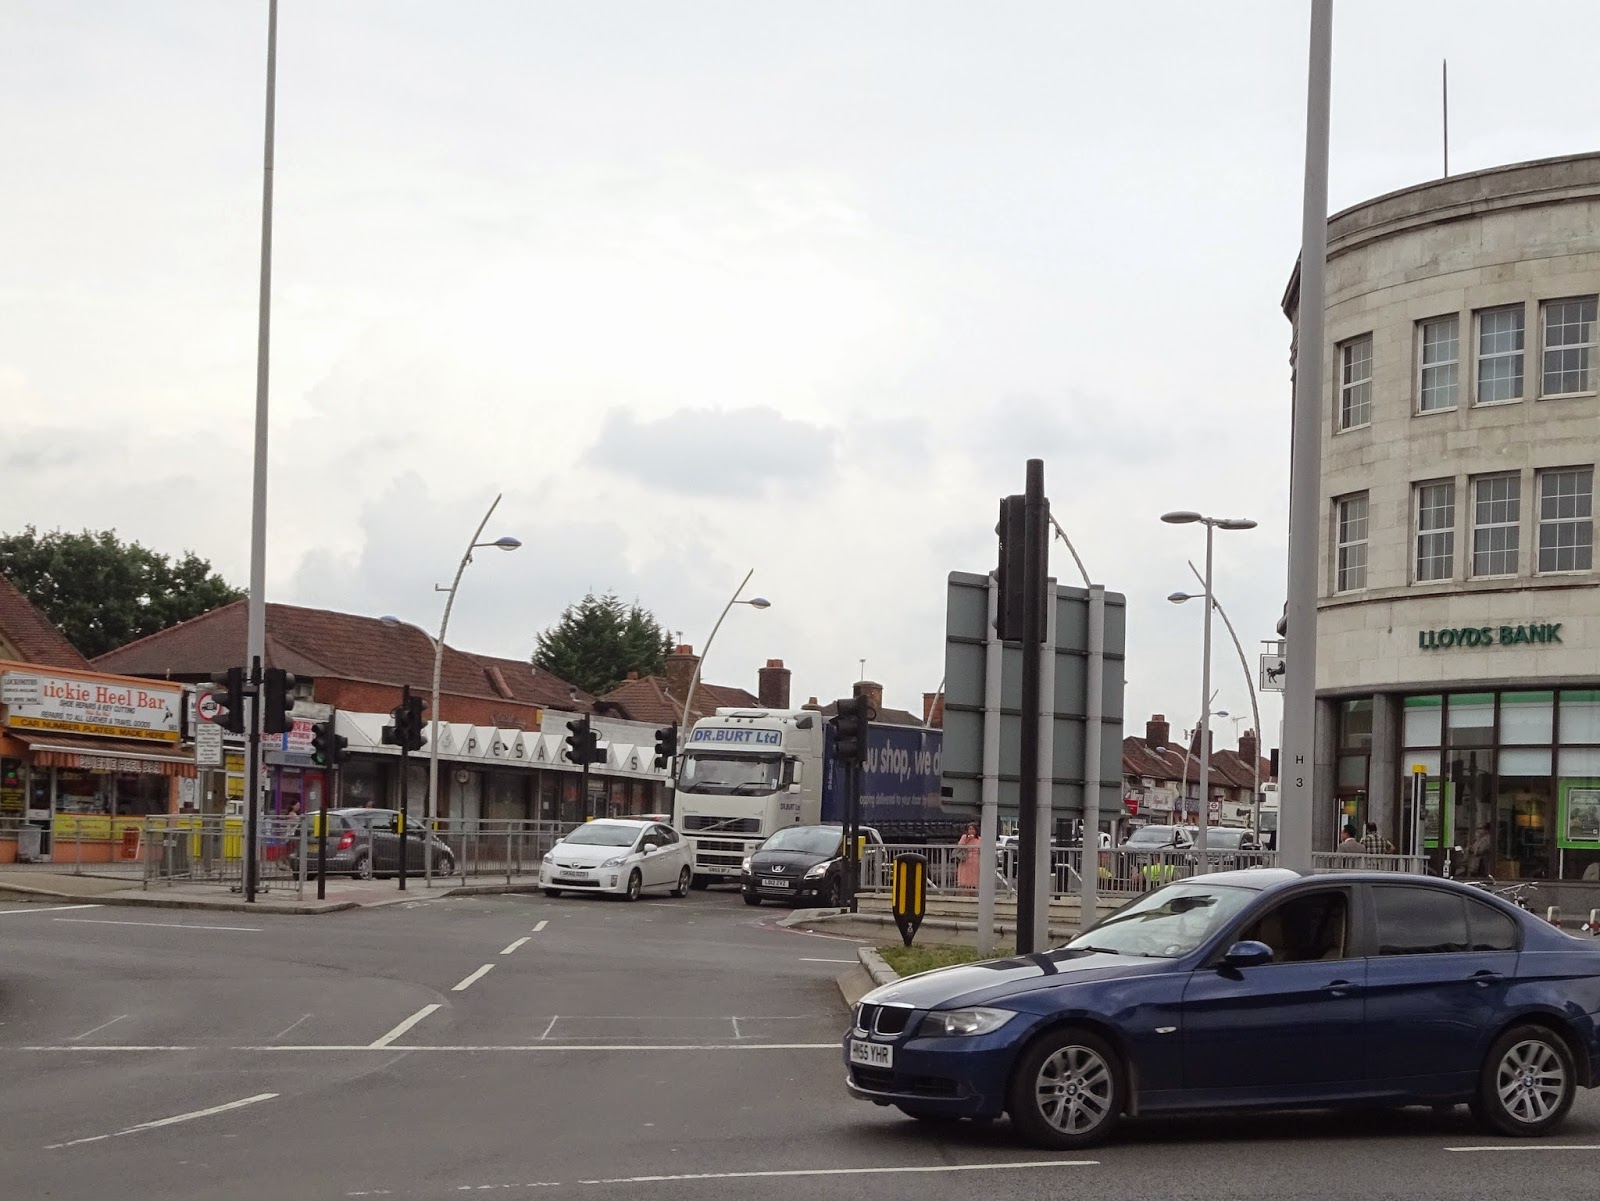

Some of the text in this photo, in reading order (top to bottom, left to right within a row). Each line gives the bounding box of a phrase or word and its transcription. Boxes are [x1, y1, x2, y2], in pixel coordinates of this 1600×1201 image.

[1418, 623, 1563, 649] LLOYDS BANK
[95, 686, 132, 706] Heel
[137, 691, 166, 709] Bar
[75, 701, 97, 710] REPAIRS
[113, 706, 136, 714] CUTTING
[21, 718, 39, 726] CAR
[42, 720, 80, 730] NUMBER
[82, 725, 115, 734] PLATES
[119, 729, 142, 737] MADE
[41, 711, 64, 720] REPAIRS
[85, 715, 107, 723] LEATHER
[113, 718, 132, 726] TRAVEL
[133, 720, 151, 728] GOODS
[756, 731, 778, 744] Ltd
[880, 739, 911, 783] shop,
[914, 751, 931, 775] we
[1296, 755, 1304, 764] H
[1296, 777, 1303, 787] 3
[870, 1045, 889, 1064] YHR
